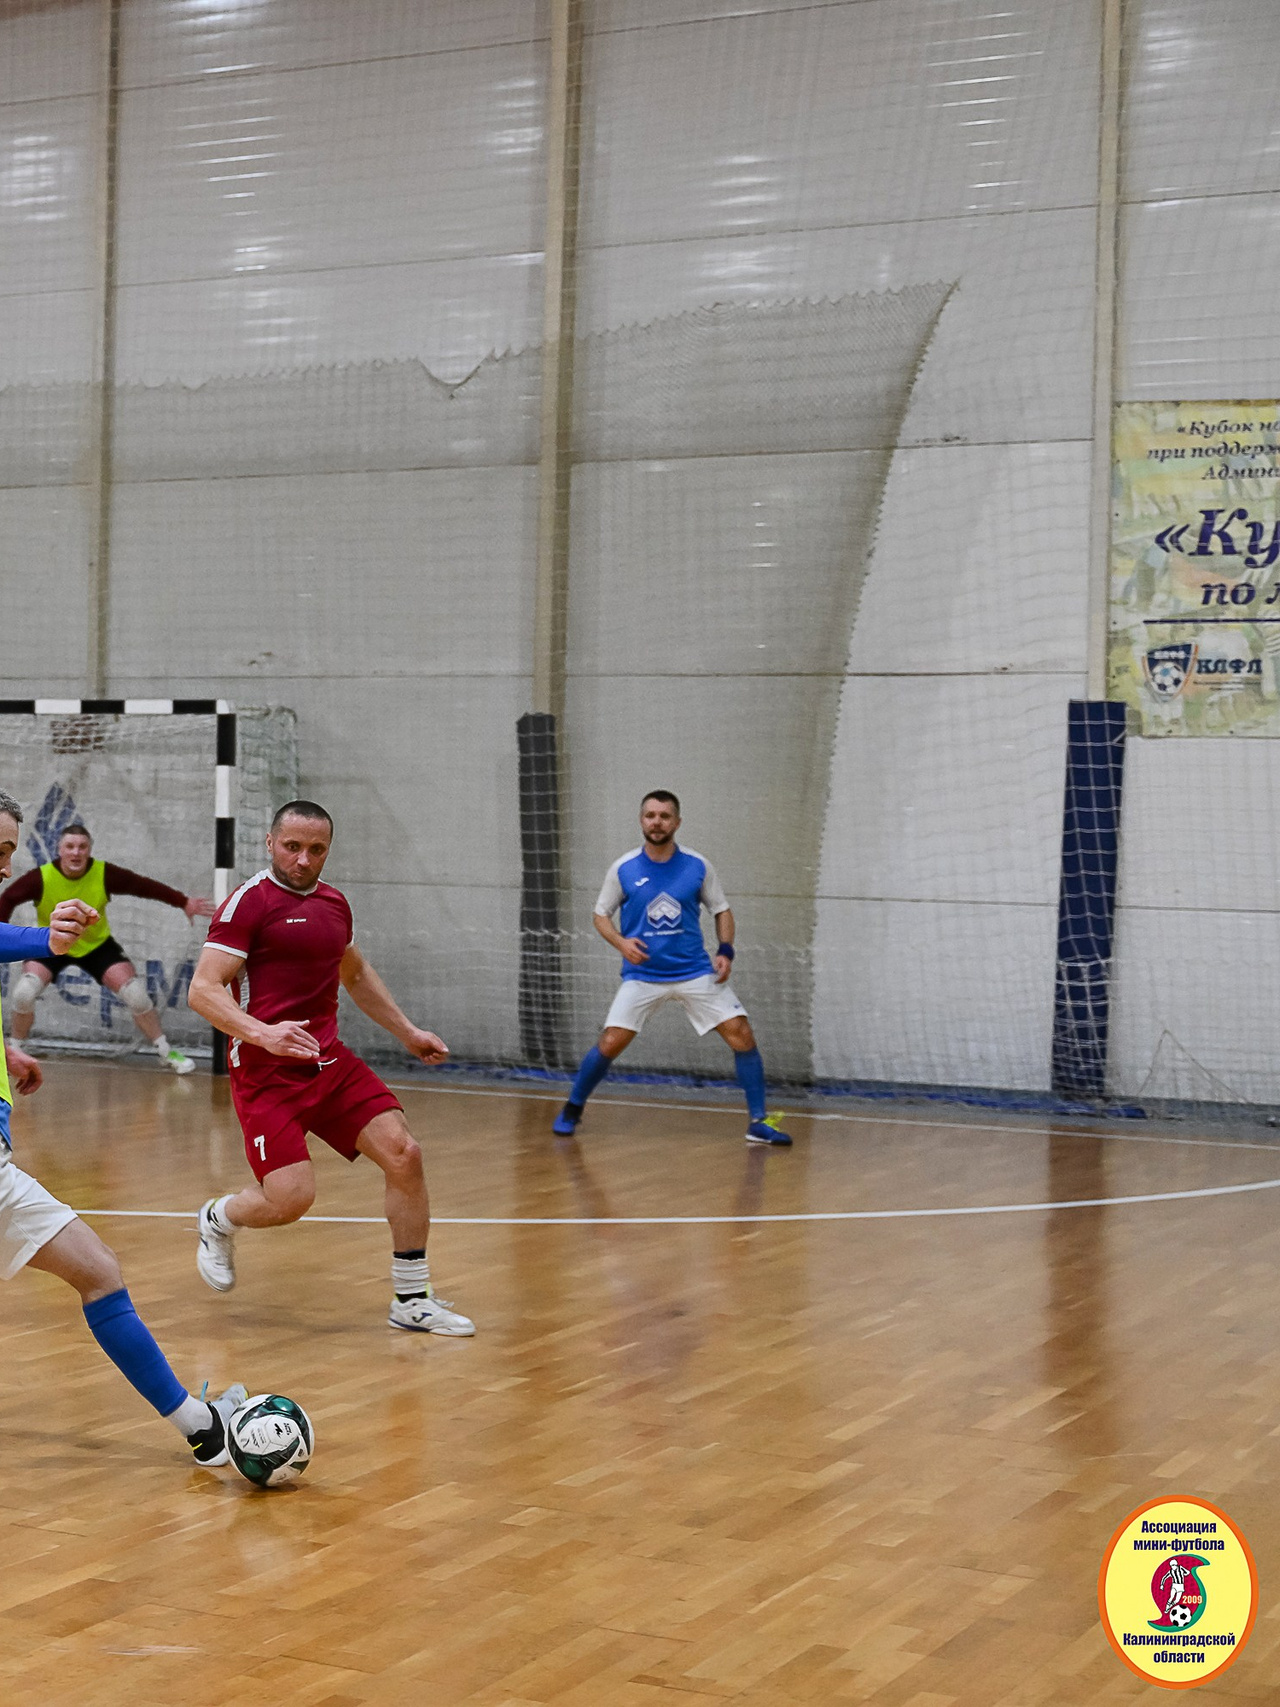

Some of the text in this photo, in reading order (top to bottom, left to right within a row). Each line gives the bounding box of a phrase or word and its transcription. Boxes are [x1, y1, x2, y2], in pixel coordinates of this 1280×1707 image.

[1177, 419, 1253, 438] «Кубок
[1147, 447, 1185, 462] при
[1155, 508, 1280, 568] «Ку
[1201, 583, 1256, 605] по
[254, 1134, 266, 1161] 7
